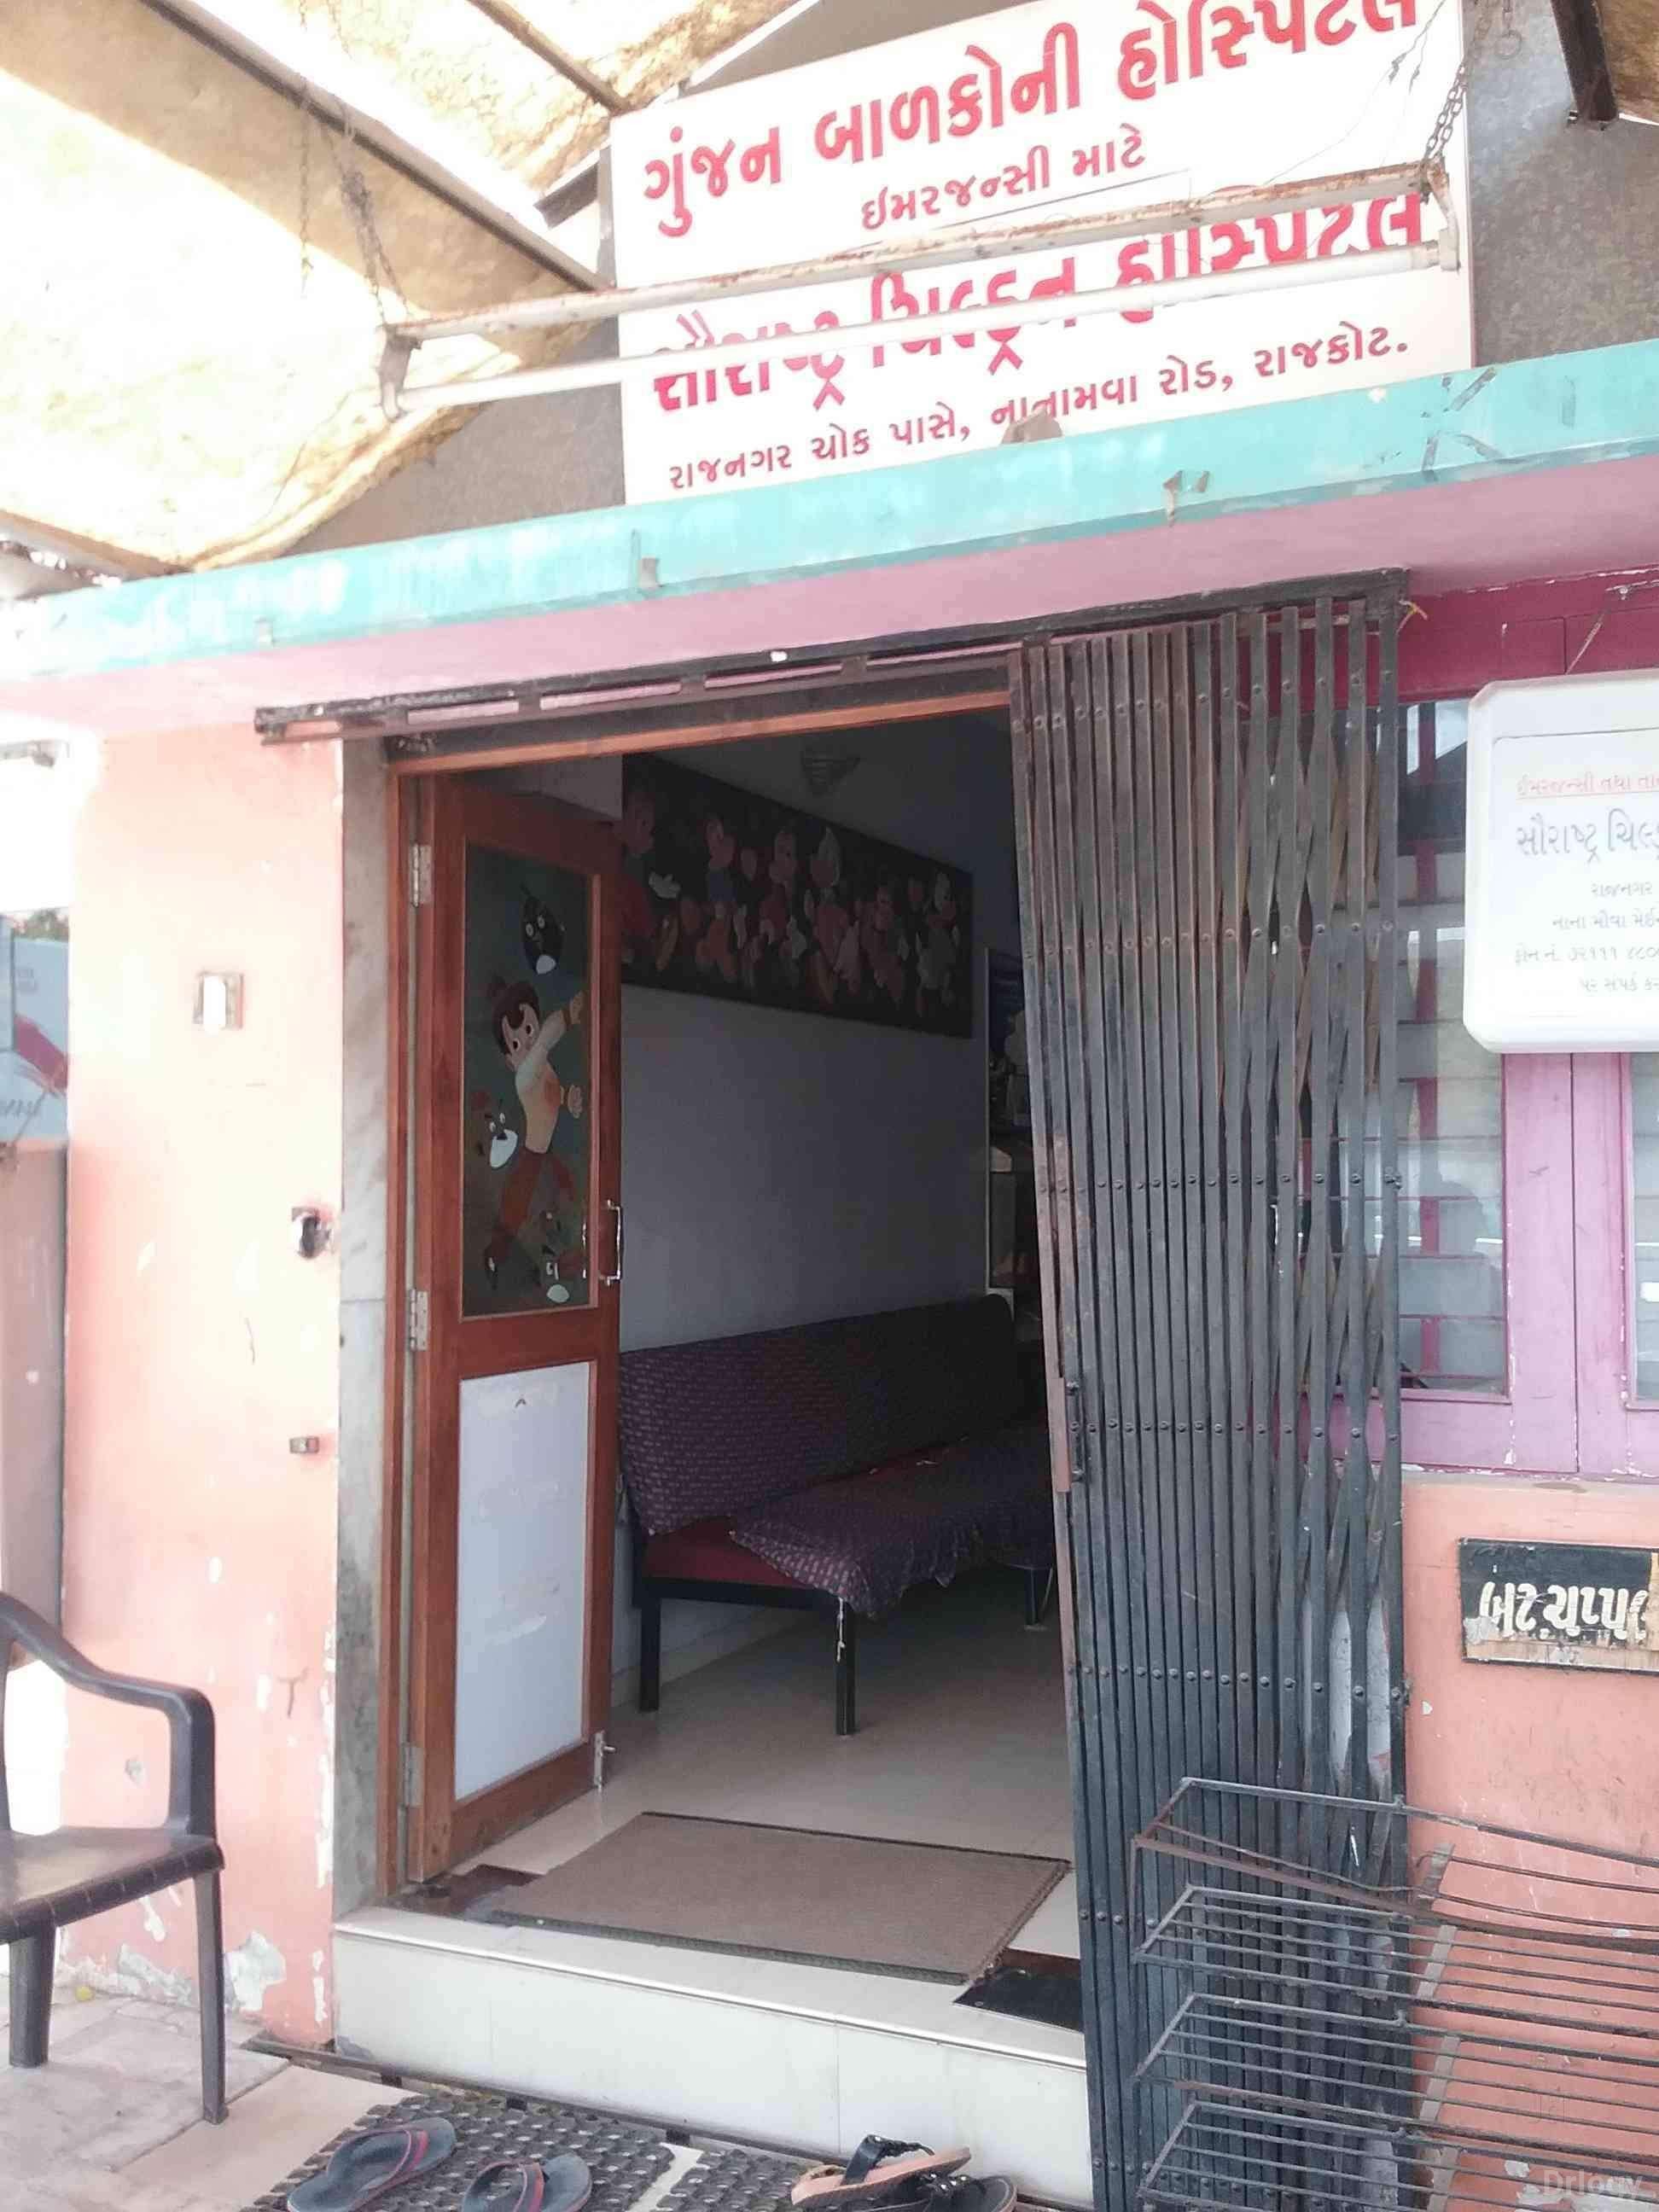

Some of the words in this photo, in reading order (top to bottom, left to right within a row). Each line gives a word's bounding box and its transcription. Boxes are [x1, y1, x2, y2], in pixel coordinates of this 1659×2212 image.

[644, 126, 782, 237] ગુંજન
[814, 22, 1080, 164] બાળકોની
[1072, 123, 1146, 176] માટે
[1115, 186, 1423, 323] હસ્પિટલ
[669, 441, 792, 489] રાજનગર
[812, 423, 871, 461] ચોક
[888, 401, 970, 445] પાસે,
[1159, 354, 1233, 395] રોડ,
[1254, 320, 1409, 378] રાજકોટ.
[1516, 812, 1601, 865] સૌરાષ્ટ્ર
[1607, 807, 1659, 860] ચિલ્
